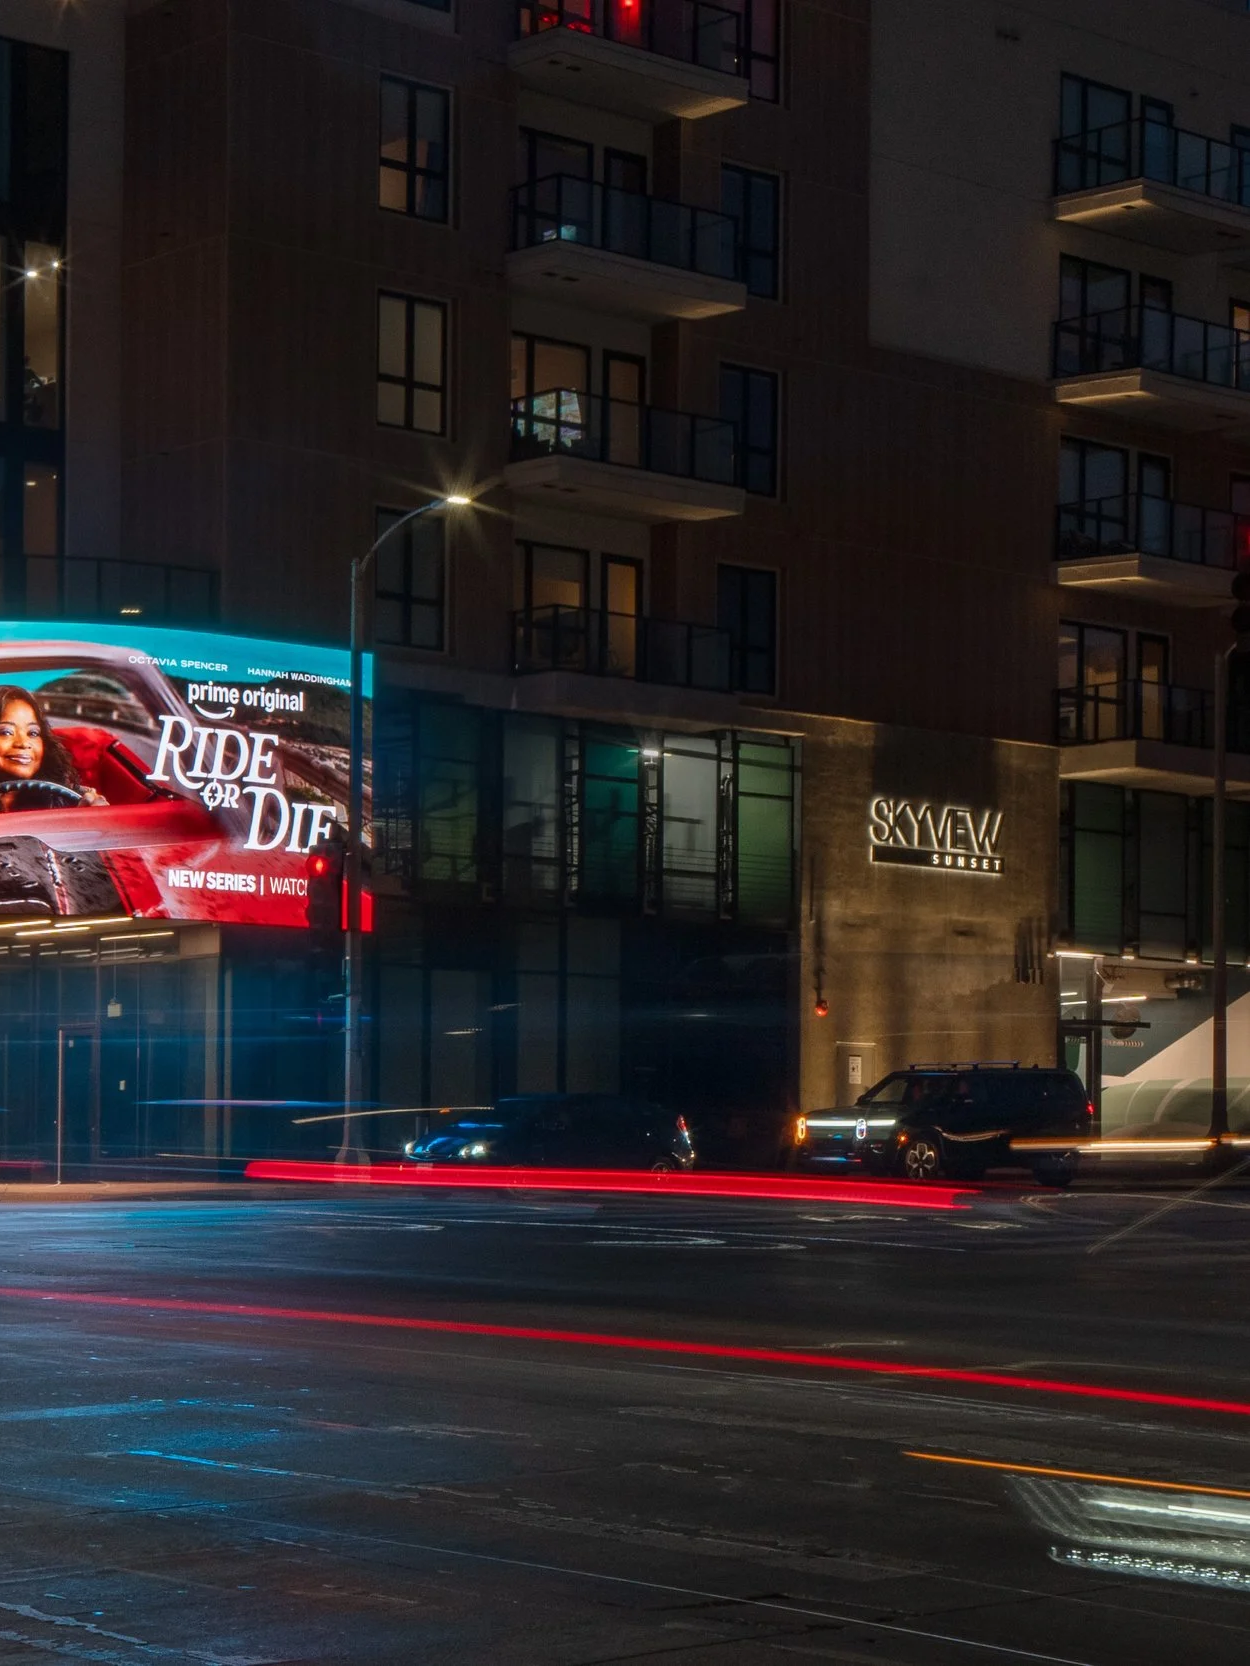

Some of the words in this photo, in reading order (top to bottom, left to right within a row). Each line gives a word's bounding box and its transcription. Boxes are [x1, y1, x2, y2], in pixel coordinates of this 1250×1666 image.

[128, 655, 178, 667] OCTAVIA
[180, 659, 228, 672] SPENCER
[247, 667, 289, 680] HANNAH
[187, 680, 239, 704] prime
[242, 686, 304, 712] original
[146, 715, 279, 790] RIDE
[200, 778, 241, 811] OR
[932, 854, 1001, 871] SUNSET
[168, 869, 205, 889] NEW
[206, 871, 256, 892] SERIES
[270, 876, 308, 896] WATC
